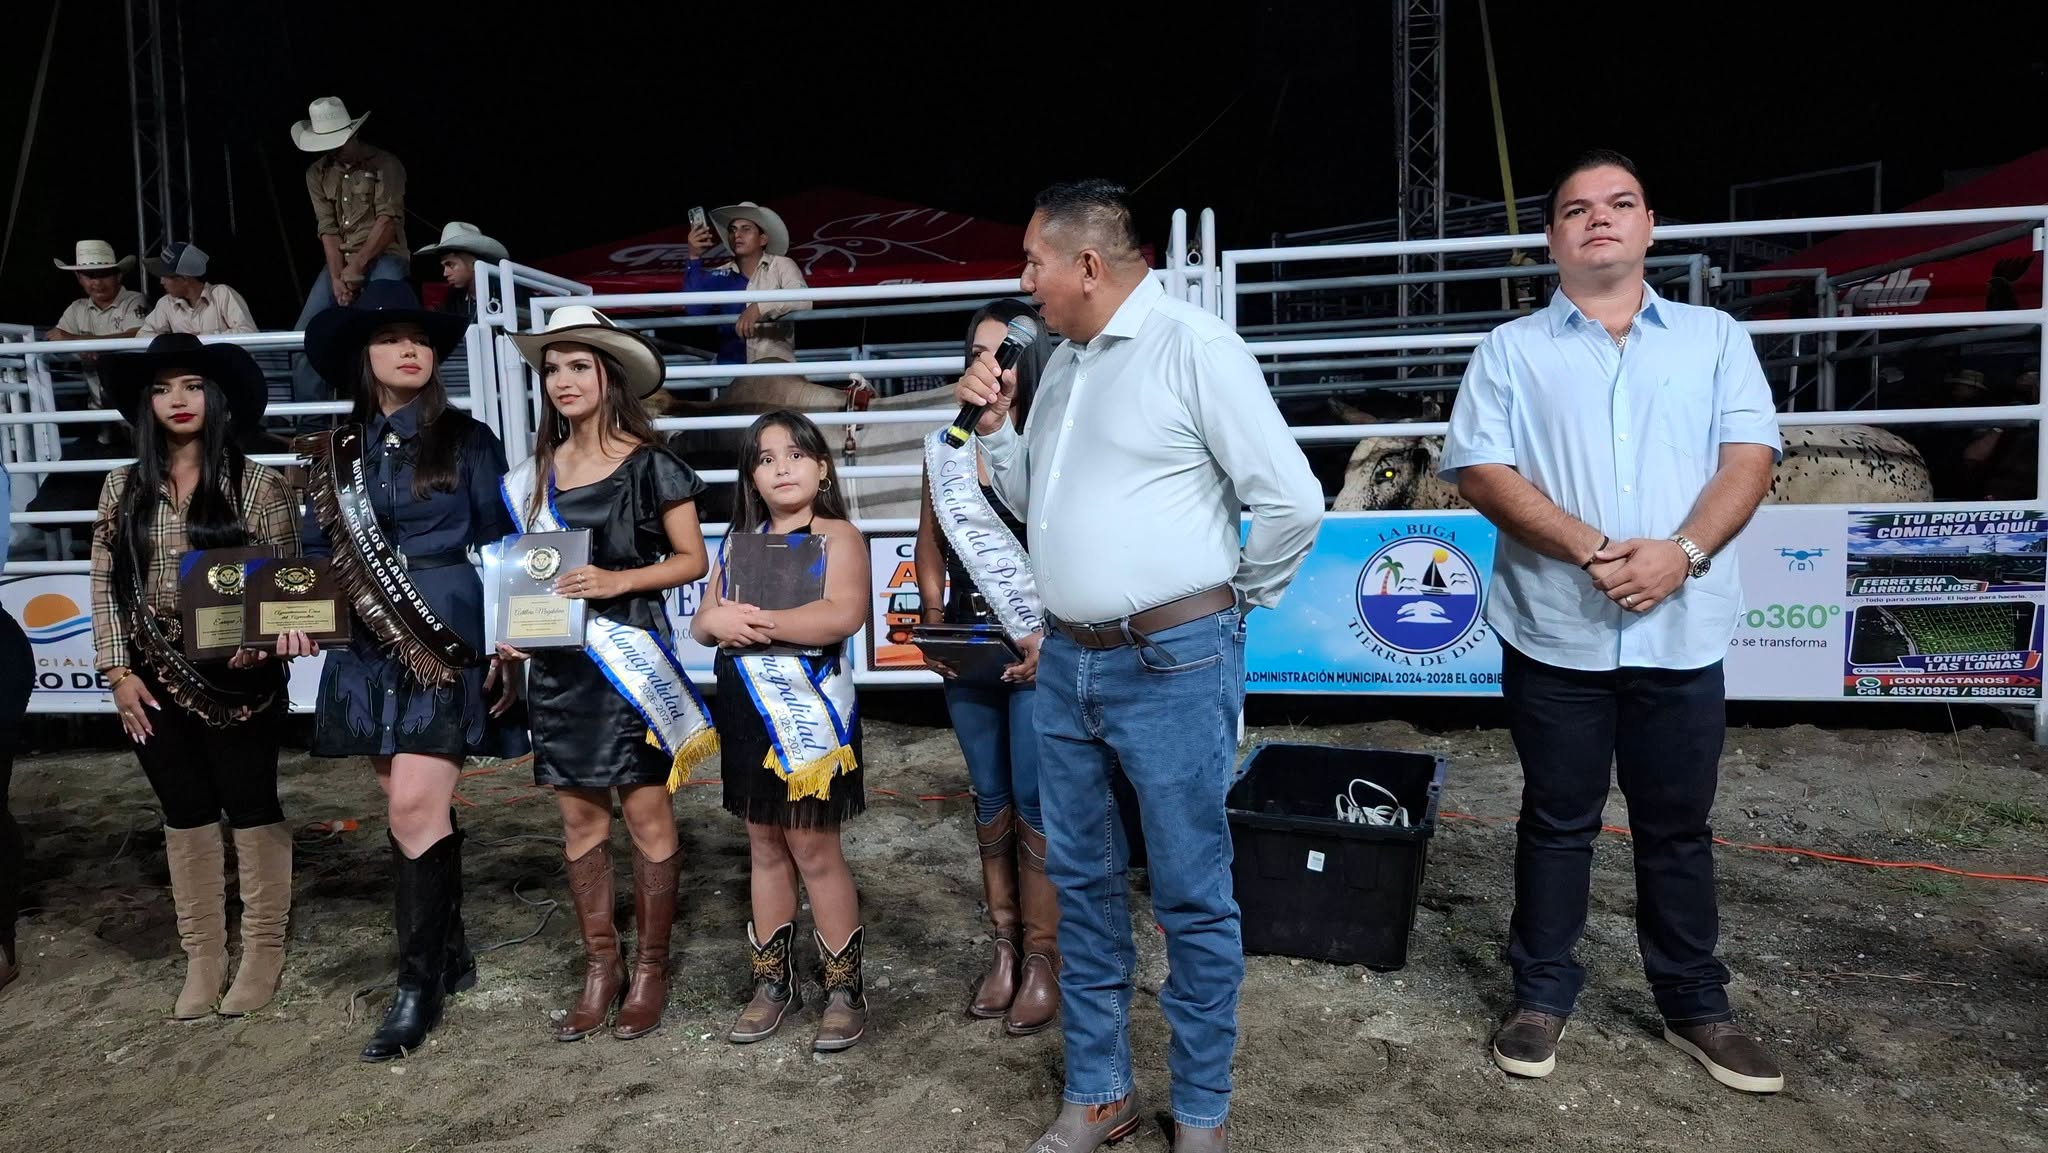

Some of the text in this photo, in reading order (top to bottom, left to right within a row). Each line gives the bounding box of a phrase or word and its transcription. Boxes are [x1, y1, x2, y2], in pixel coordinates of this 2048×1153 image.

[940, 460, 969, 525] Novia
[966, 529, 998, 557] del
[1930, 510, 2025, 524] PROYECTO
[1378, 523, 1457, 543] LA BUGA
[1876, 519, 2038, 539] COMIENZA AQUÍ!
[347, 505, 403, 604] AGRICULTORES
[352, 457, 444, 632] NOVIA DE LOS GANADEROS
[1858, 583, 1979, 594] BARRIO SAN JOSÉ
[1862, 576, 1947, 586] FERRETERÍA
[1741, 604, 1840, 629] o360°
[1347, 616, 1413, 667] TIERRA
[1420, 654, 1447, 668] DE
[1742, 638, 1756, 646] se
[1760, 637, 1827, 648] transforma
[1924, 652, 2021, 664] LOTIFICACIÓN
[1927, 660, 2024, 673] LAS LOMAS
[594, 615, 685, 722] Municipalidad
[1245, 669, 1335, 684] ADMINISTRACIÓN
[1336, 672, 1394, 684] MUNICIPAL
[1395, 672, 1454, 684] 2024-2028
[1456, 673, 1467, 683] EL
[1889, 675, 2010, 686] ¡CONTÁCTANOS!
[1856, 687, 1885, 696] Cel.
[1889, 686, 1958, 696] 45370975
[1970, 687, 2036, 697] 58861762
[638, 682, 673, 726] 2026-2027
[775, 708, 805, 761] 2026-2027
